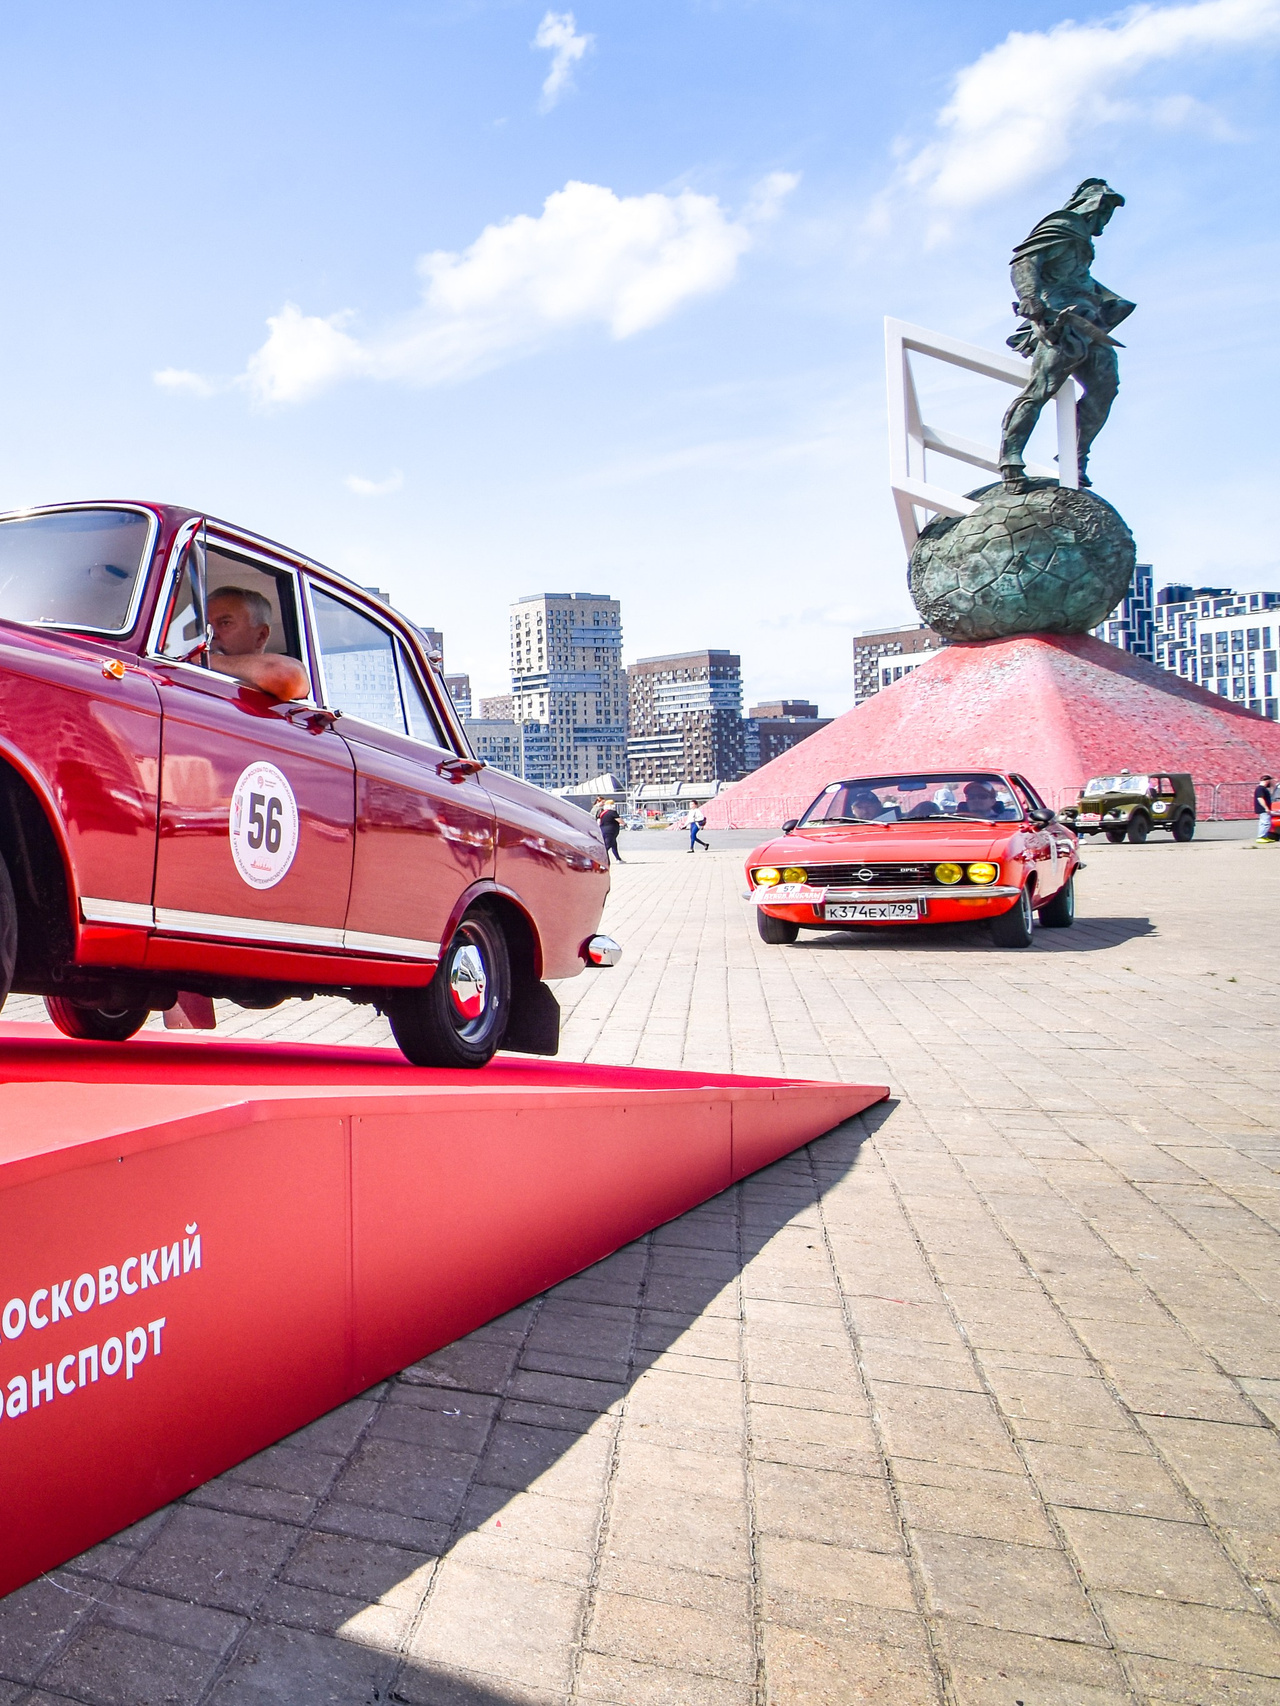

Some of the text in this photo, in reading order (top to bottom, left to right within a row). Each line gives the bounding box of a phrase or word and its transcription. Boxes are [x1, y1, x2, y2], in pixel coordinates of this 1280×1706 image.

[247, 792, 283, 854] 56
[783, 885, 795, 893] 57
[889, 904, 913, 914] 799
